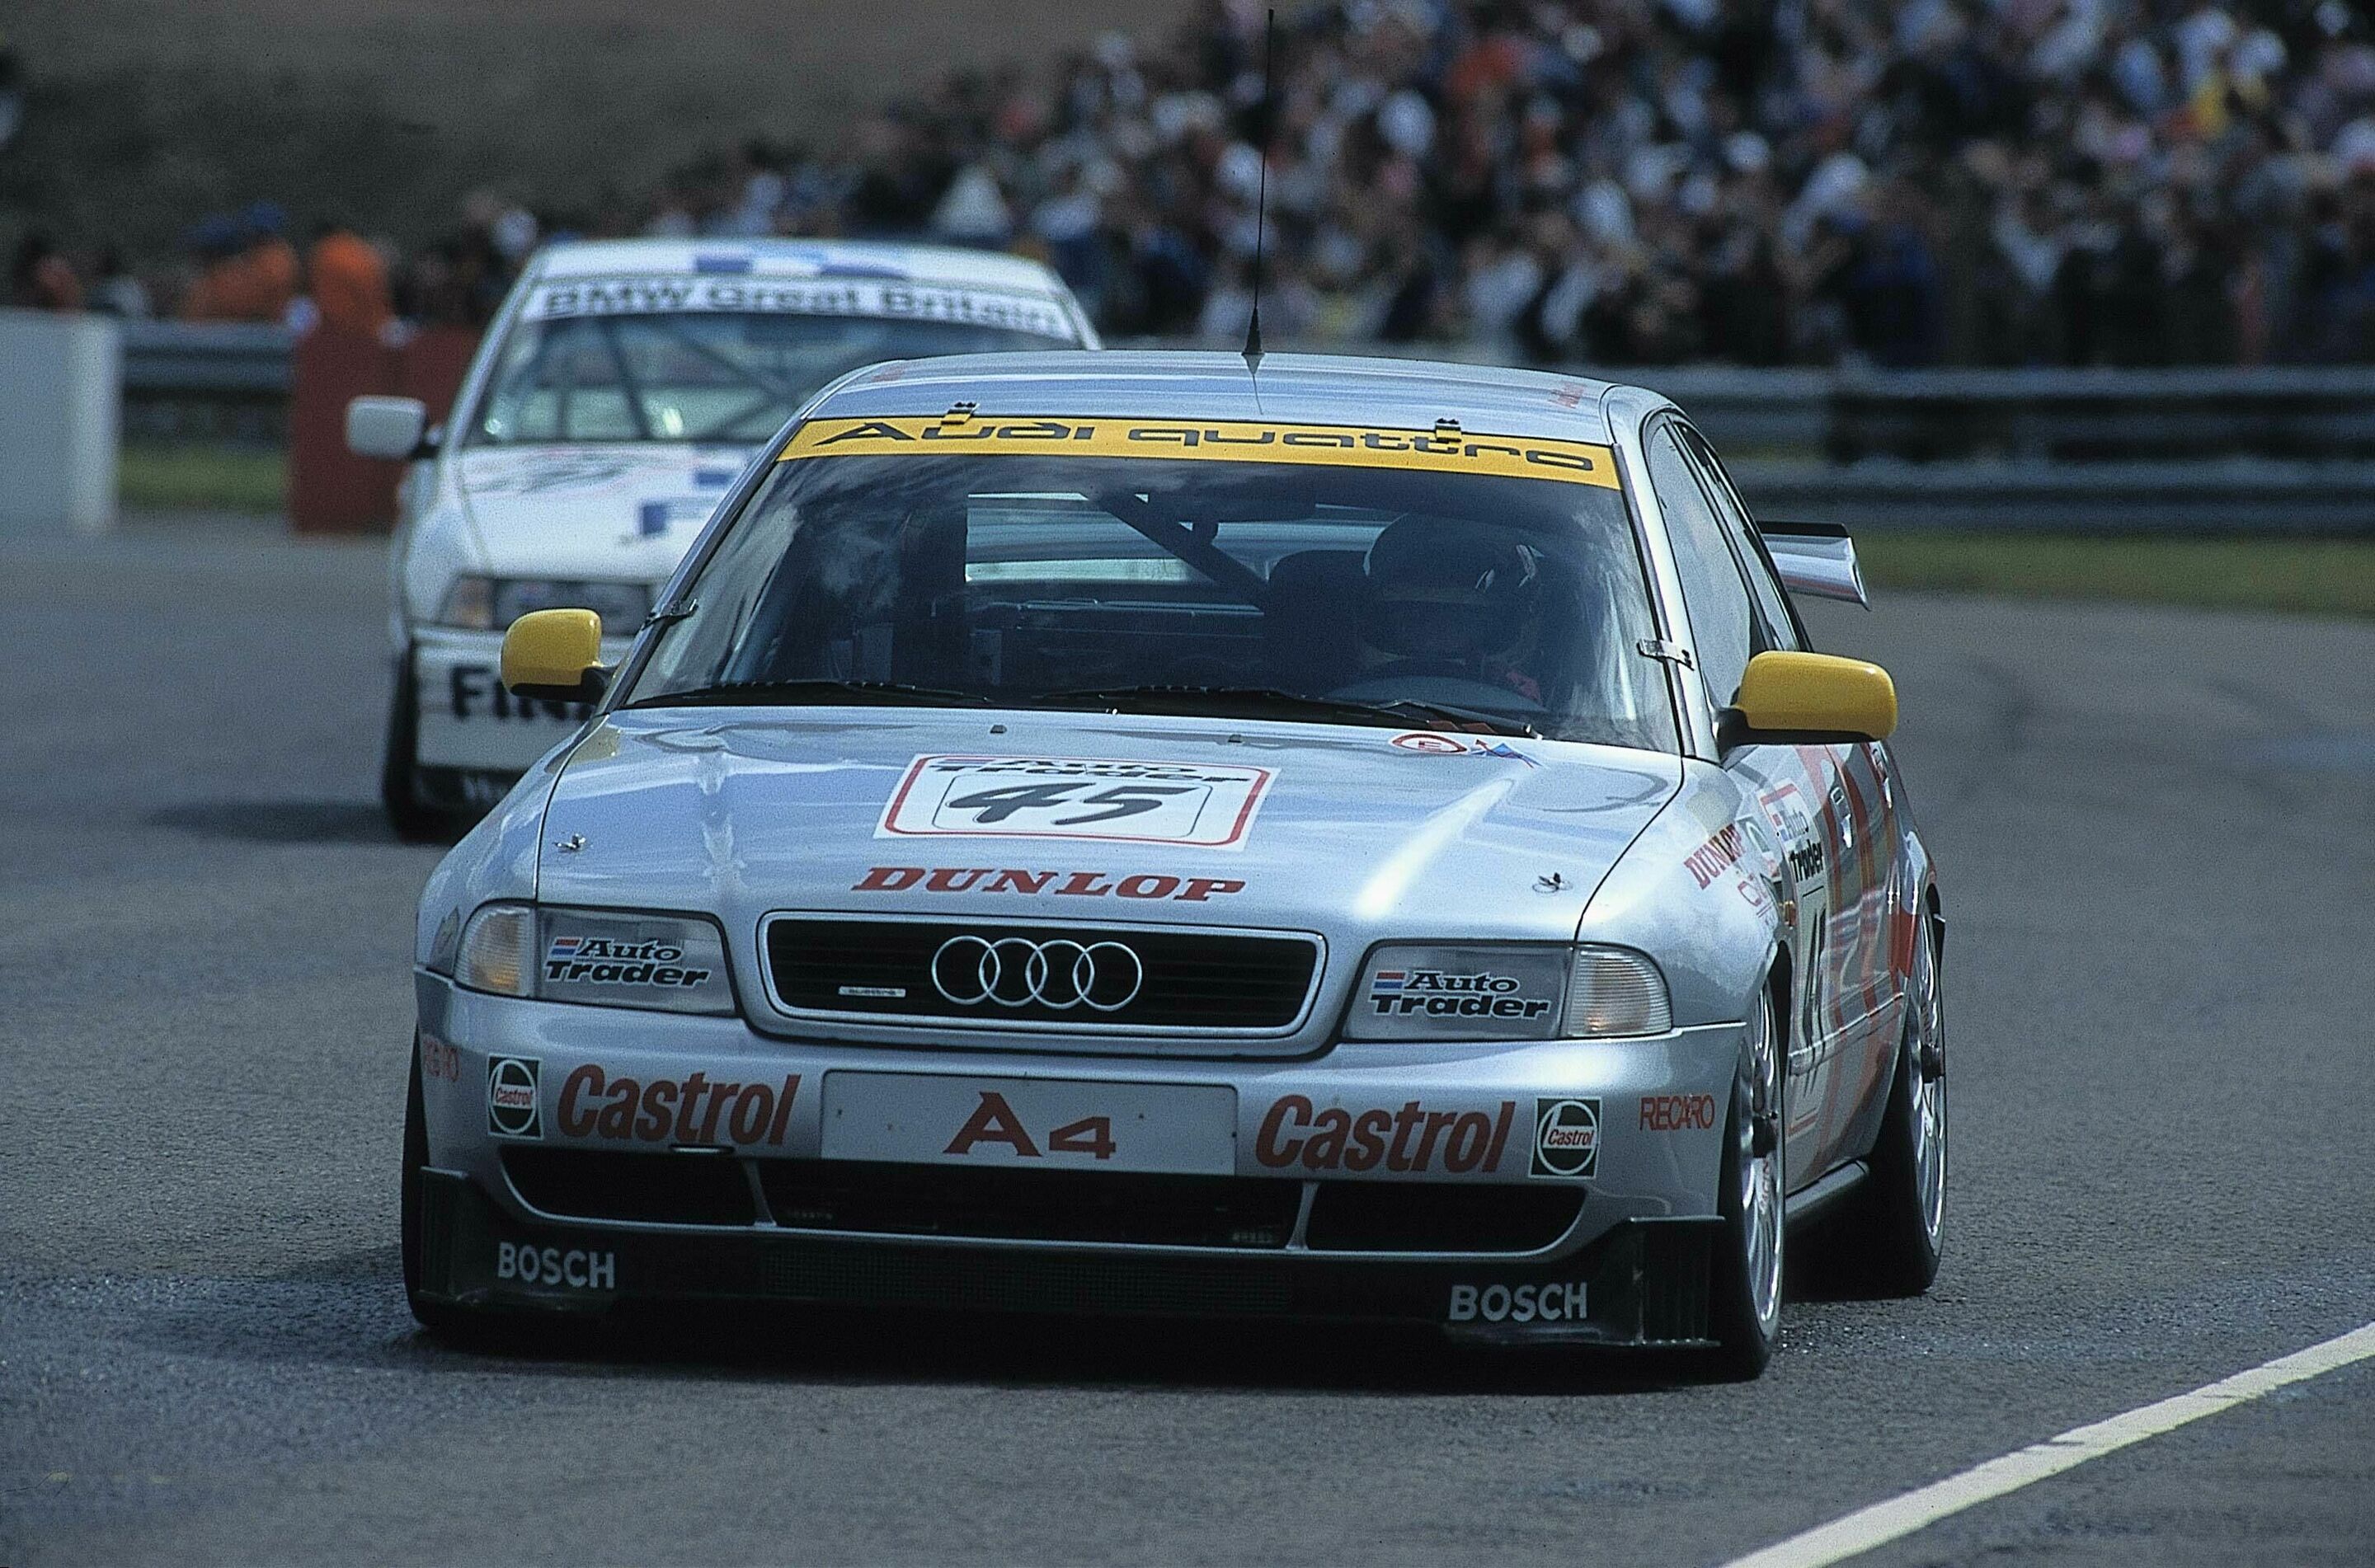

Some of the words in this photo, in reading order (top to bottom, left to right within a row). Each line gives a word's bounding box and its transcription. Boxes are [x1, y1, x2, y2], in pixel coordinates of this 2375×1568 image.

[812, 422, 1094, 446] Audi
[1128, 428, 1593, 471] quattro
[929, 765, 1249, 782] Trader
[1004, 760, 1197, 772] Auto
[945, 782, 1200, 825] 45
[851, 866, 1245, 902] DUNLOP
[576, 937, 683, 961] Auto
[543, 960, 710, 988] Trader
[1403, 970, 1518, 993] Auto
[1370, 992, 1550, 1018] Trader
[496, 1086, 534, 1106] Castrol
[557, 1064, 801, 1145] Castrol
[1639, 1095, 1715, 1131] RECARO
[943, 1091, 1116, 1160] A4
[1255, 1095, 1516, 1173] Castrol
[1548, 1127, 1594, 1147] Castrol
[497, 1242, 615, 1289] BOSCH
[1449, 1282, 1587, 1322] BOSCH
